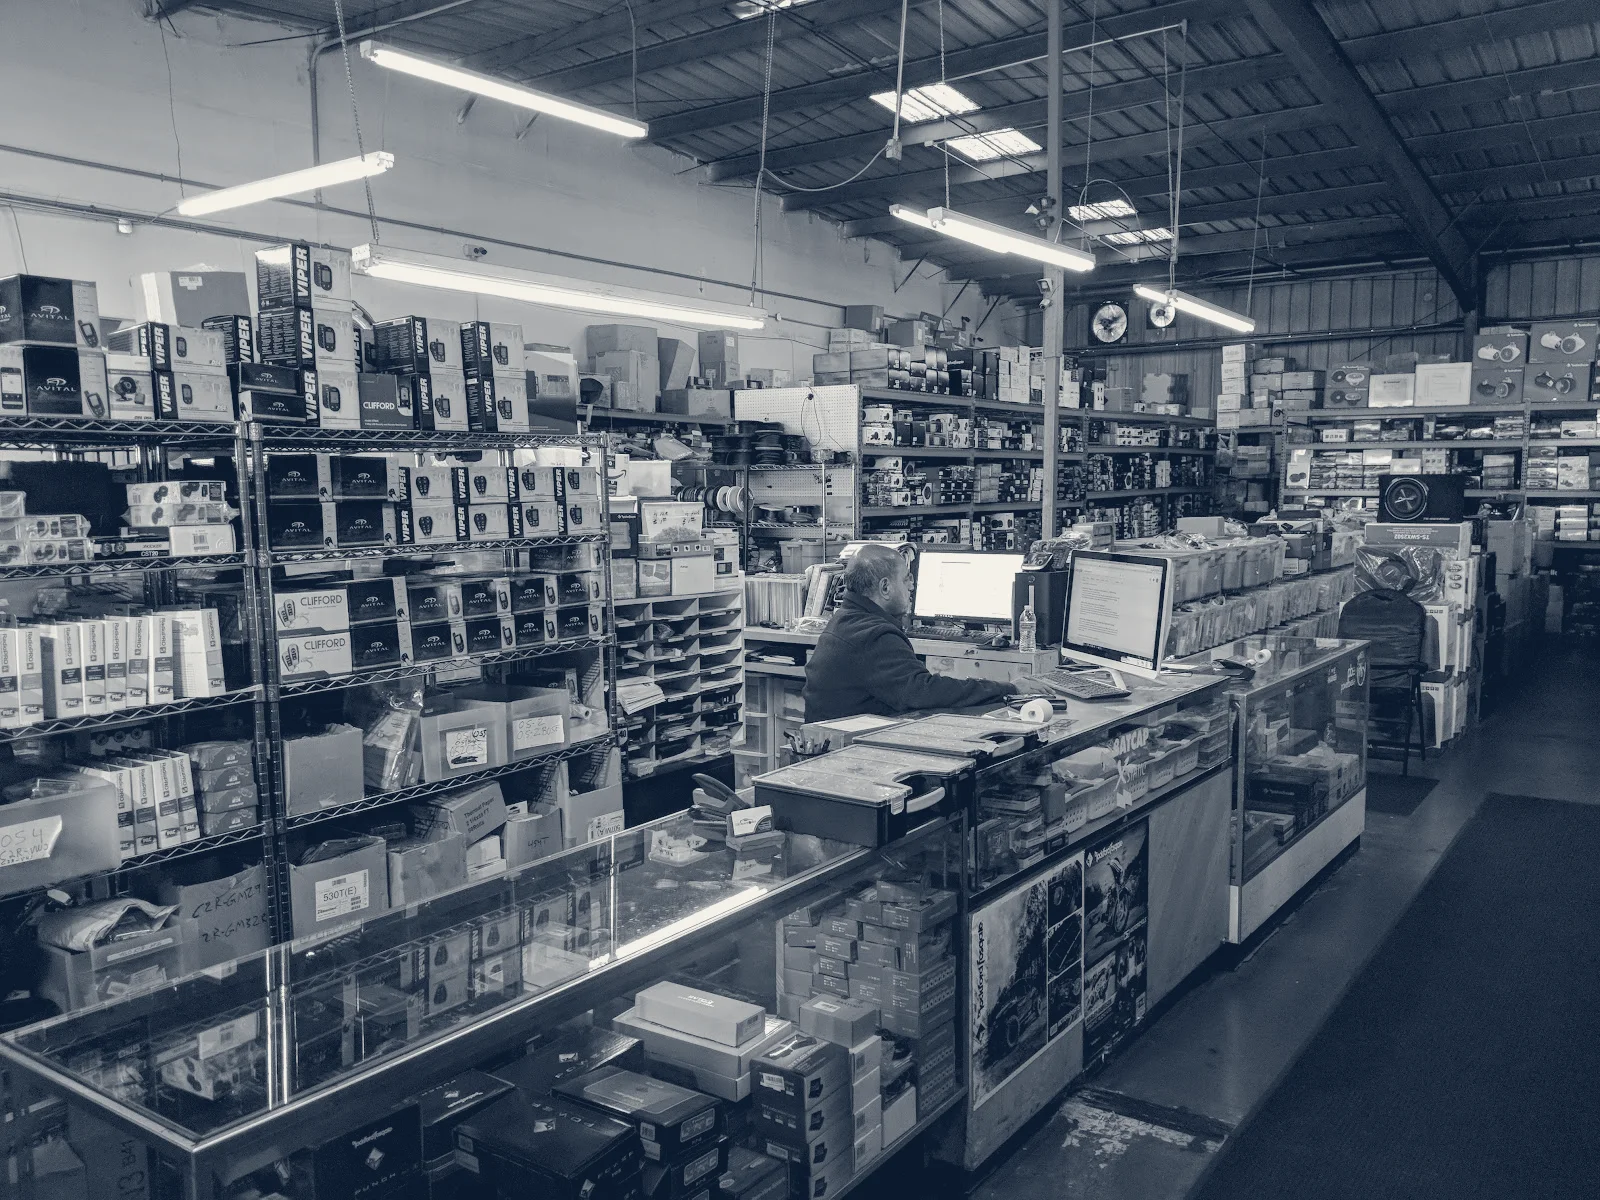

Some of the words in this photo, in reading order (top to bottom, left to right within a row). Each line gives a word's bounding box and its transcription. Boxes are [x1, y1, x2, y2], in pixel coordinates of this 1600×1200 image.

[296, 246, 308, 297] VIPER
[30, 312, 71, 321] AVITAL
[154, 326, 166, 365] VIPER
[300, 309, 313, 360] VIPER
[414, 320, 426, 354] VIPER
[479, 325, 491, 358] VIPER
[36, 385, 78, 393] AVITAL
[159, 375, 173, 413] VIPER
[305, 371, 318, 422] VIPER
[419, 377, 431, 411] VIPER
[484, 380, 494, 413] VIPER
[363, 401, 395, 410] CLIFFORD
[399, 468, 411, 501] VIPER
[458, 467, 468, 500] VIPER
[508, 468, 516, 499] VIPER
[555, 468, 563, 498] VIPER
[401, 509, 412, 542] VIPER
[458, 506, 466, 538] VIPER
[513, 505, 522, 536] VIPER
[558, 504, 567, 533] VIPER
[300, 594, 343, 607] CLIFFORD
[304, 637, 347, 651] CLIFFORD
[1114, 728, 1149, 756] BATCAP
[464, 803, 483, 819] Thermal
[323, 885, 357, 902] 530T(E)
